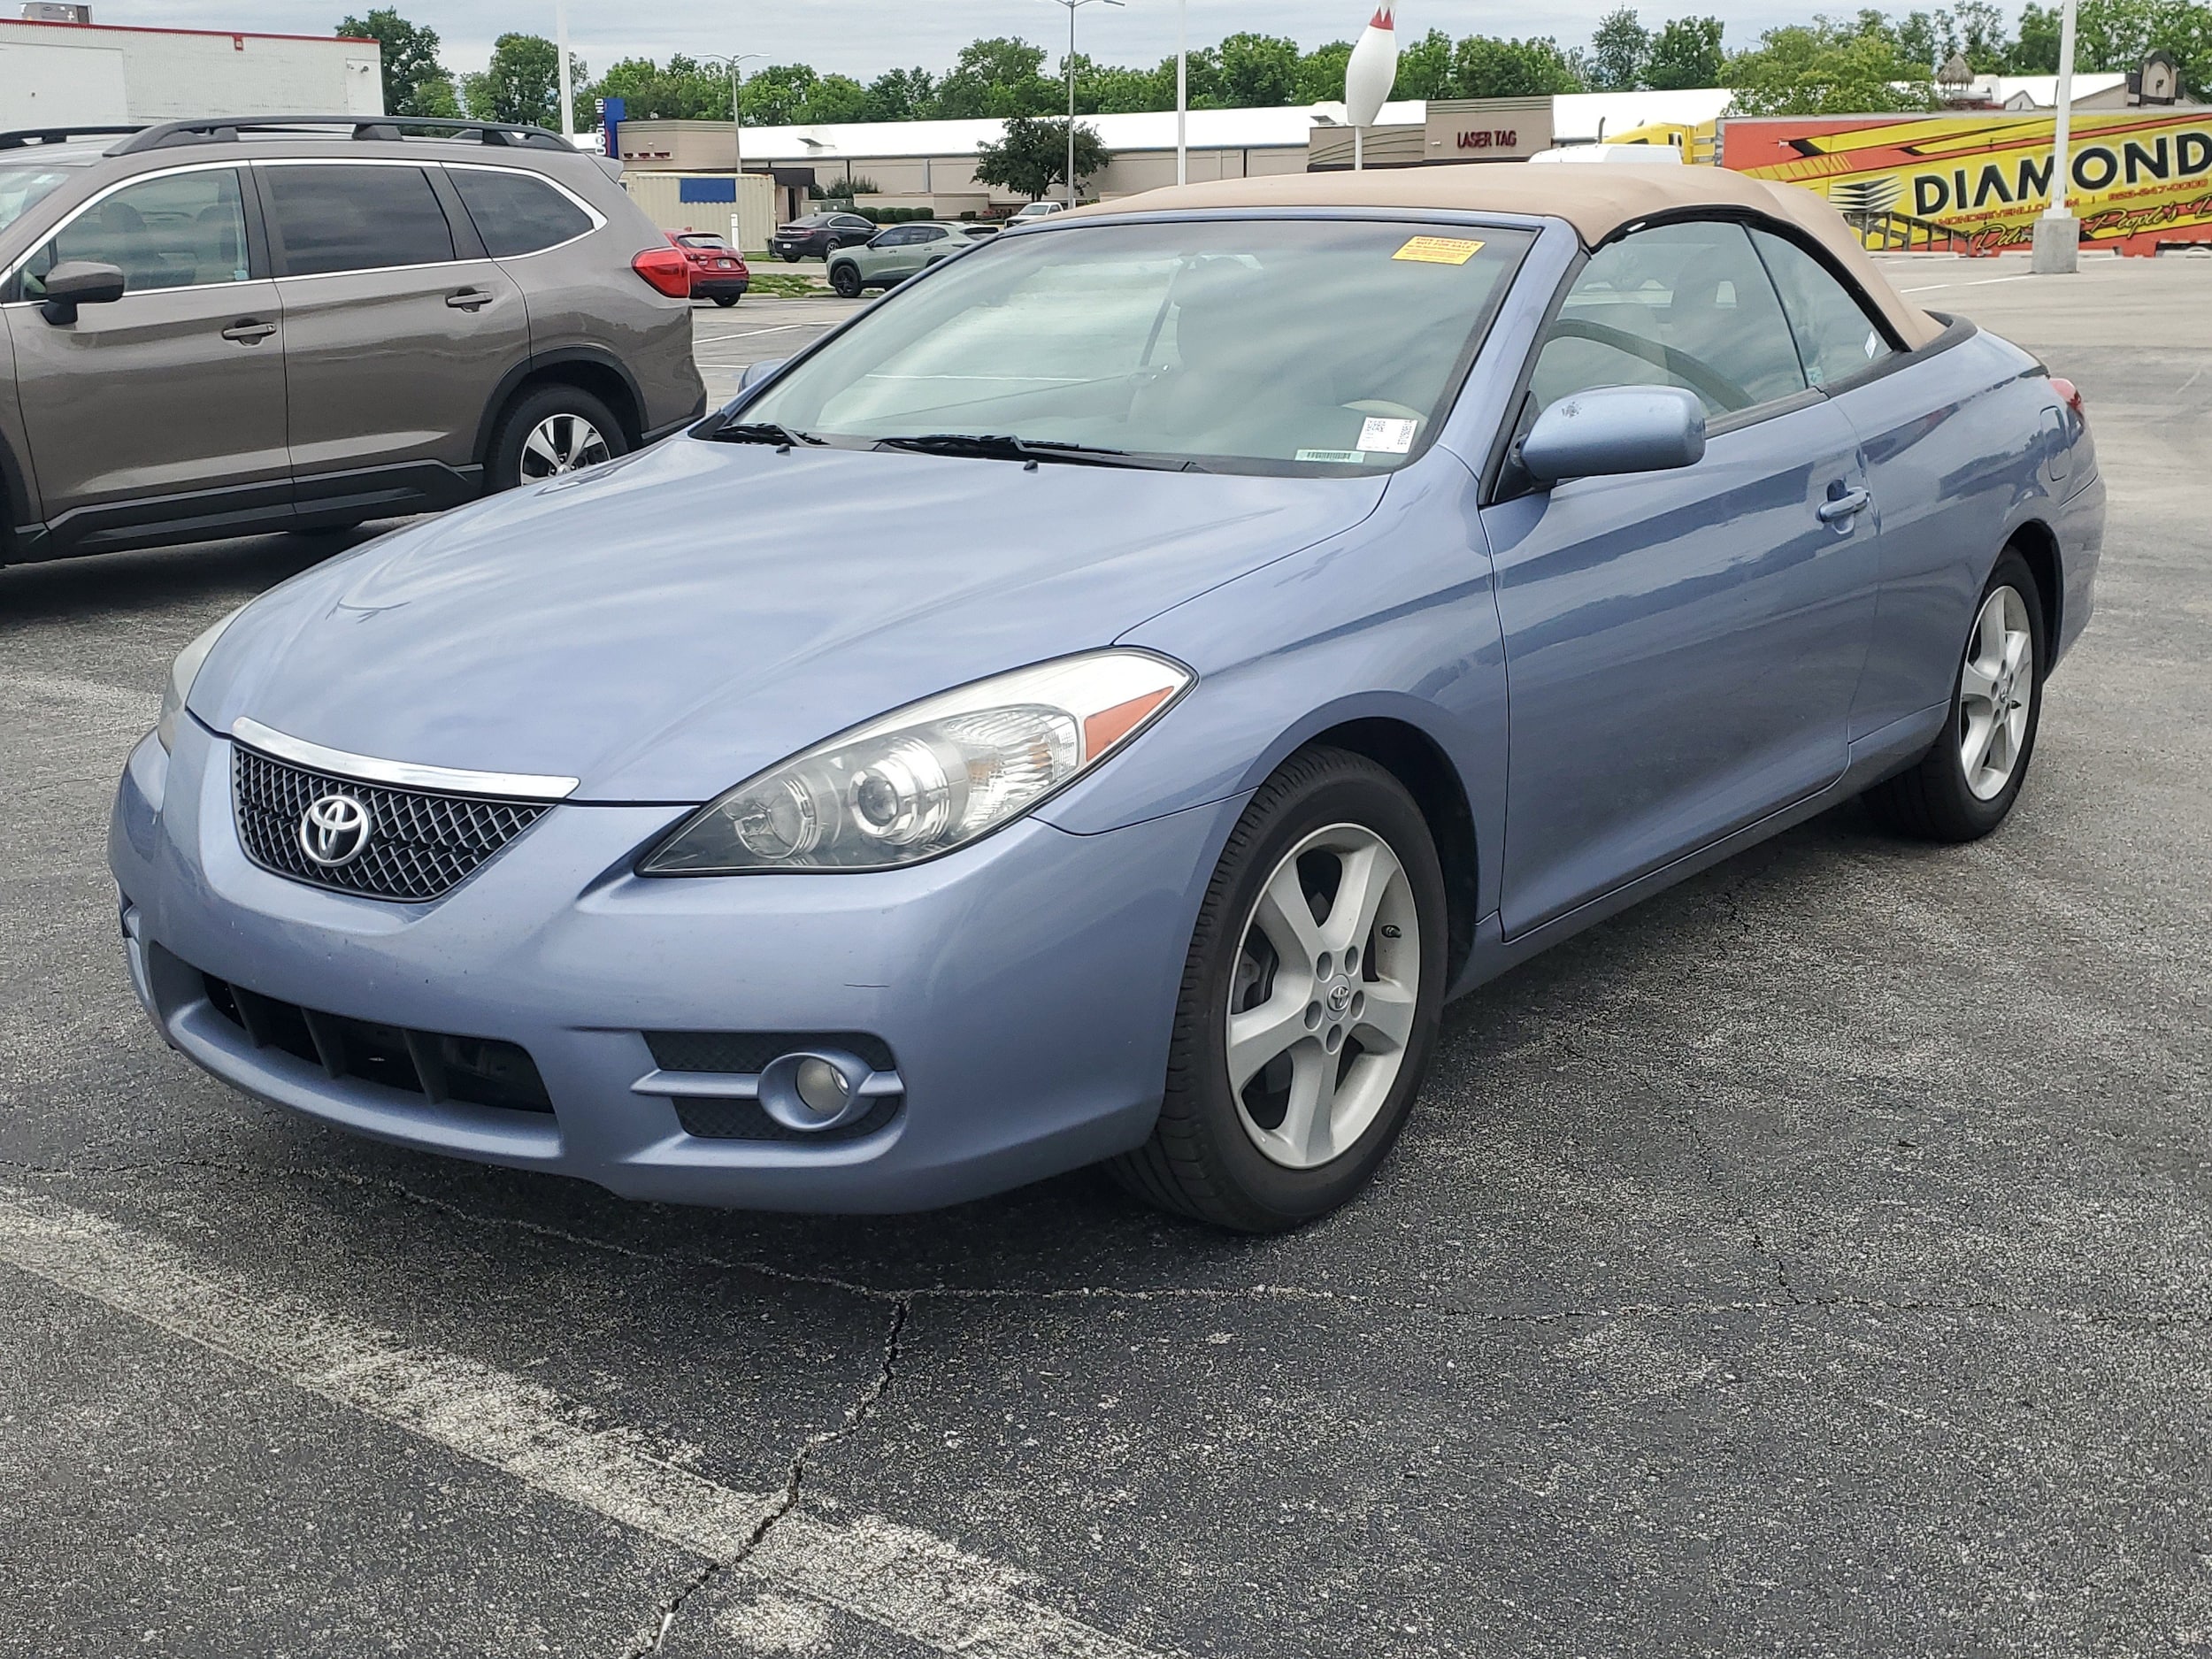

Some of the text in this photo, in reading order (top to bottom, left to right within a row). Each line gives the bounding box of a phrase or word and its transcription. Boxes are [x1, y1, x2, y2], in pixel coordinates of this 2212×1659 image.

[1457, 130, 1517, 149] LASER TAG
[1914, 133, 2212, 216] DIAMOND
[2085, 201, 2177, 240] People's
